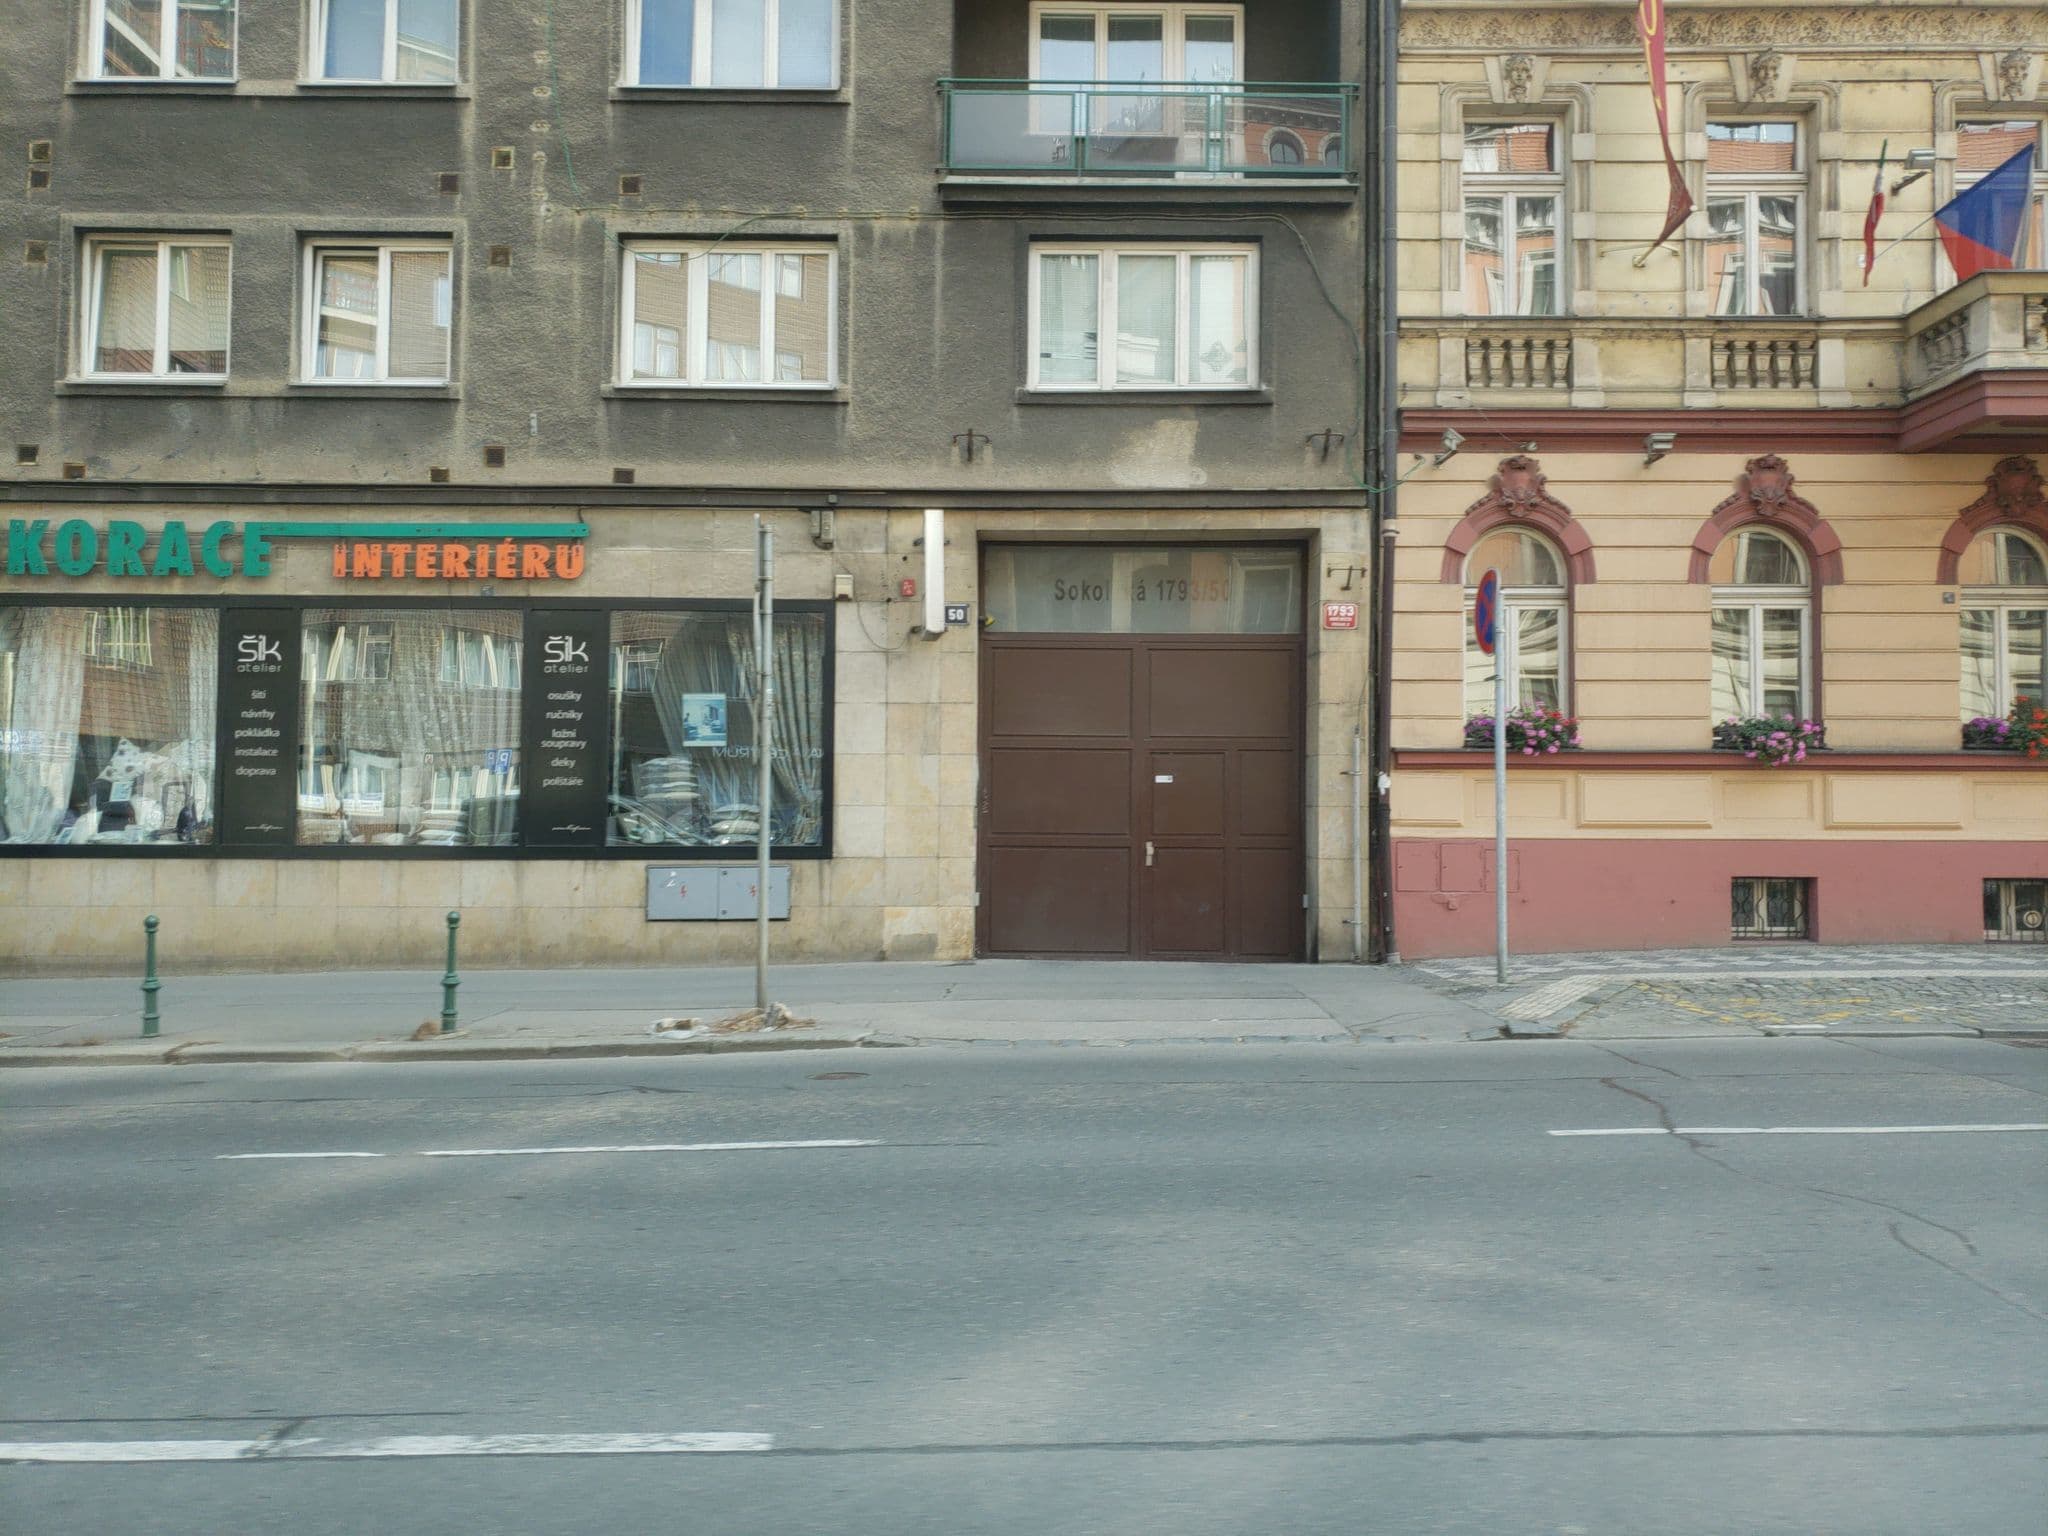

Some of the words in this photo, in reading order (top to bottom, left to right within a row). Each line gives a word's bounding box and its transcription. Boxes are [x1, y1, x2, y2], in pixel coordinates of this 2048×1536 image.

[7, 519, 273, 577] KORACE
[332, 537, 585, 580] INTERIÉRU
[948, 609, 964, 621] 50
[1327, 605, 1354, 617] 1793
[237, 663, 282, 673] atelier
[544, 663, 588, 674] atelier
[241, 708, 275, 720] návrhy
[540, 740, 587, 750] soupravy
[234, 746, 279, 757] instalace
[550, 757, 576, 769] deky
[235, 765, 277, 777] doprava
